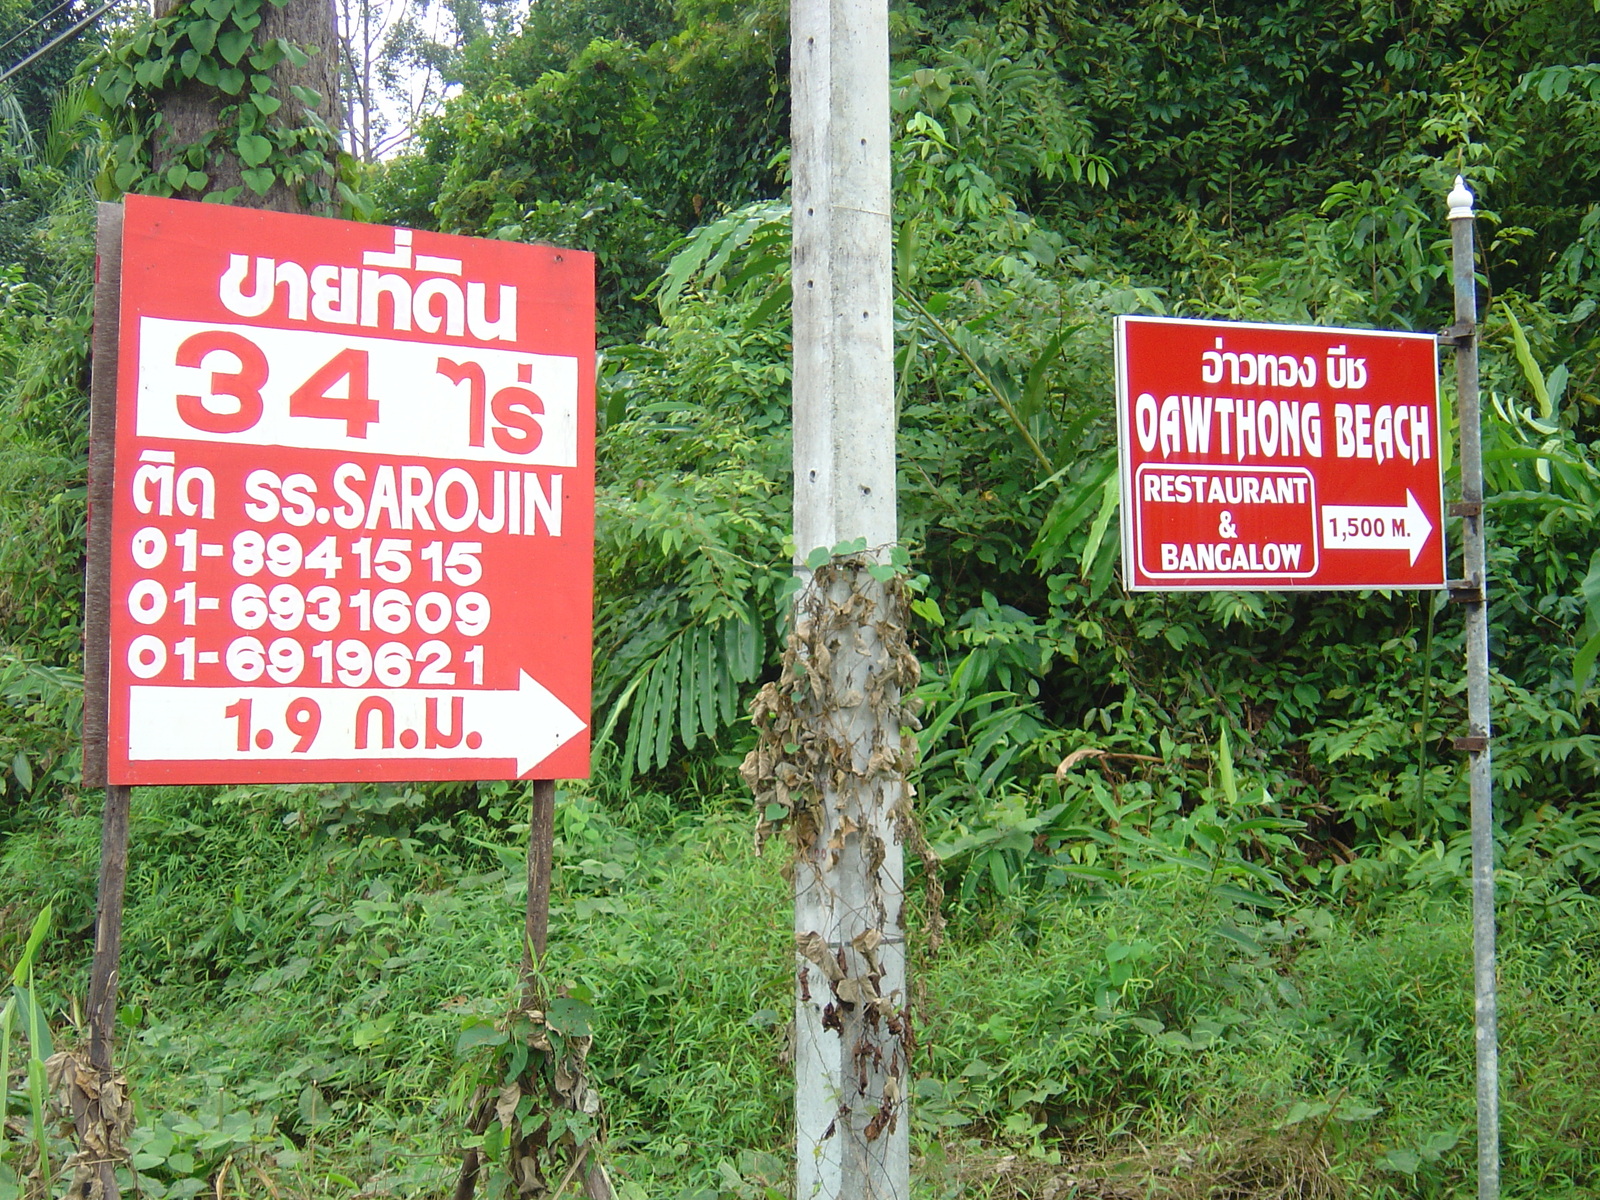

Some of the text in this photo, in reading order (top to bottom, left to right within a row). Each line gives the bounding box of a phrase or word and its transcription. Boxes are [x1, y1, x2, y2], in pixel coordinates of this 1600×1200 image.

[219, 229, 518, 342] ขายที่ดิน
[175, 330, 380, 439] 34
[1202, 337, 1317, 388] อ่าวทอง
[1135, 393, 1431, 466] OAWTHONG BEACH
[1143, 474, 1308, 504] RESTAURANT
[1218, 511, 1238, 539] &
[1329, 517, 1411, 541] 1,500 M.
[1160, 543, 1302, 571] BANGALOW
[224, 696, 322, 753] 1.9
